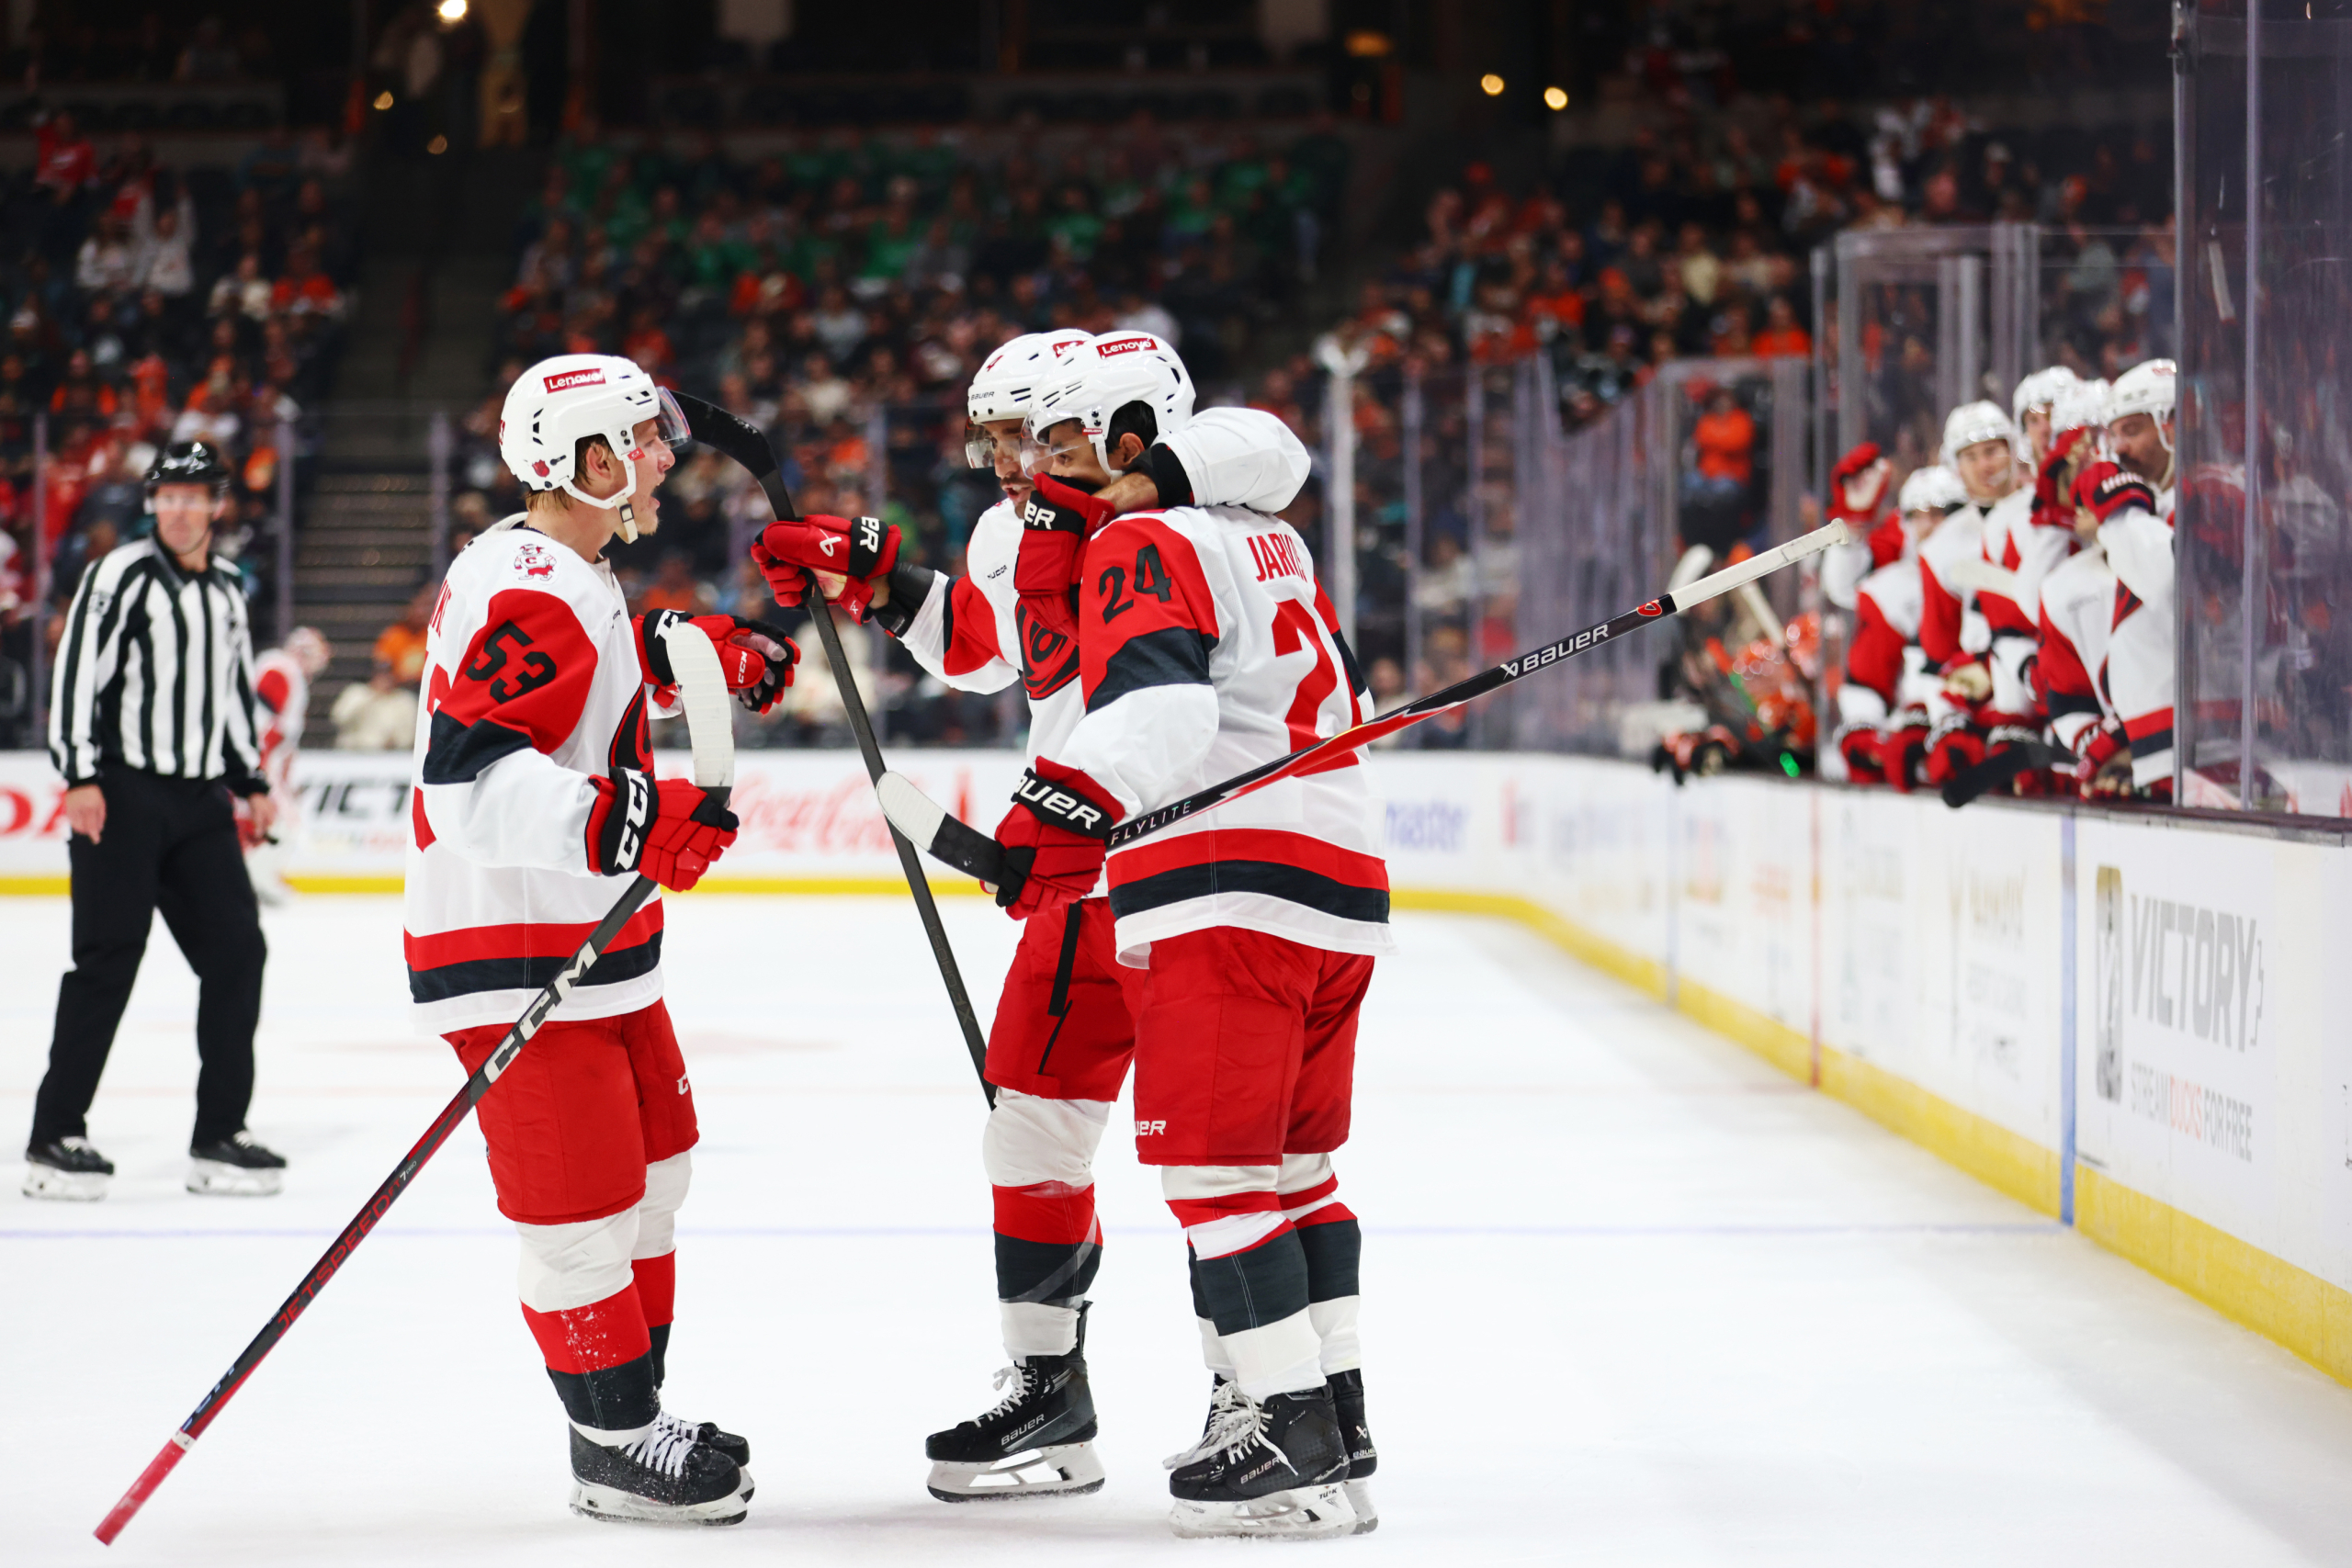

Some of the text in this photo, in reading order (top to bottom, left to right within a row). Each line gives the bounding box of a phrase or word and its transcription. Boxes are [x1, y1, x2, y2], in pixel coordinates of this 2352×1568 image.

[1102, 338, 1153, 355] Lenovo
[1099, 544, 1172, 625] 24
[466, 620, 557, 705] 53
[738, 650, 748, 684] CCM
[1110, 800, 1192, 846] FLYLITE
[483, 941, 598, 1084] CCM
[2131, 893, 2256, 1054] VICTORY
[2170, 1074, 2202, 1141] DUCKS
[2204, 1086, 2224, 1153] FOR
[2226, 1096, 2253, 1164] FREE
[277, 1194, 391, 1338] JETSPEED
